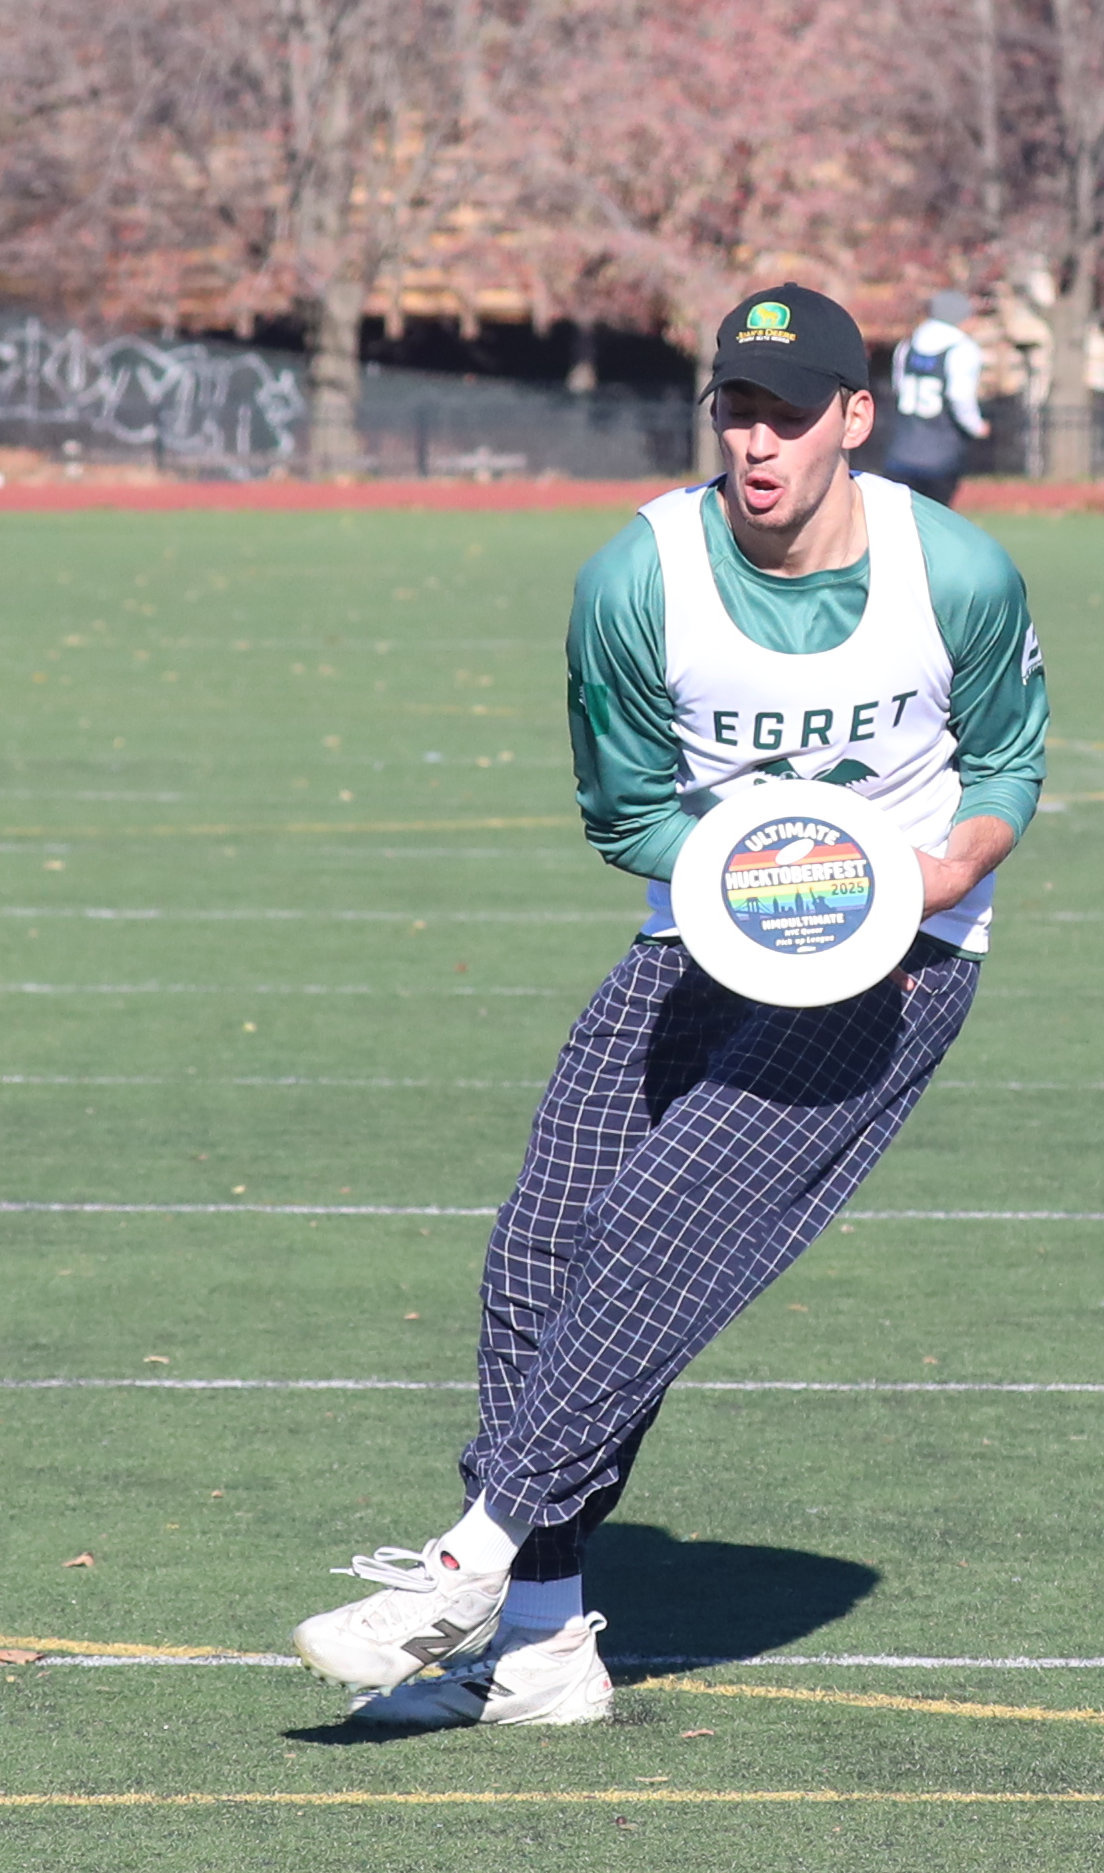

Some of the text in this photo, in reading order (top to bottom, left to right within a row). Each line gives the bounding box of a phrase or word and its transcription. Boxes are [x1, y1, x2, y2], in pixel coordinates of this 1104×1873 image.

[713, 690, 918, 750] EGRET
[744, 821, 840, 852] ULTIMATE
[725, 859, 867, 890] HUCKTOBERFEST
[831, 882, 865, 896] 2025
